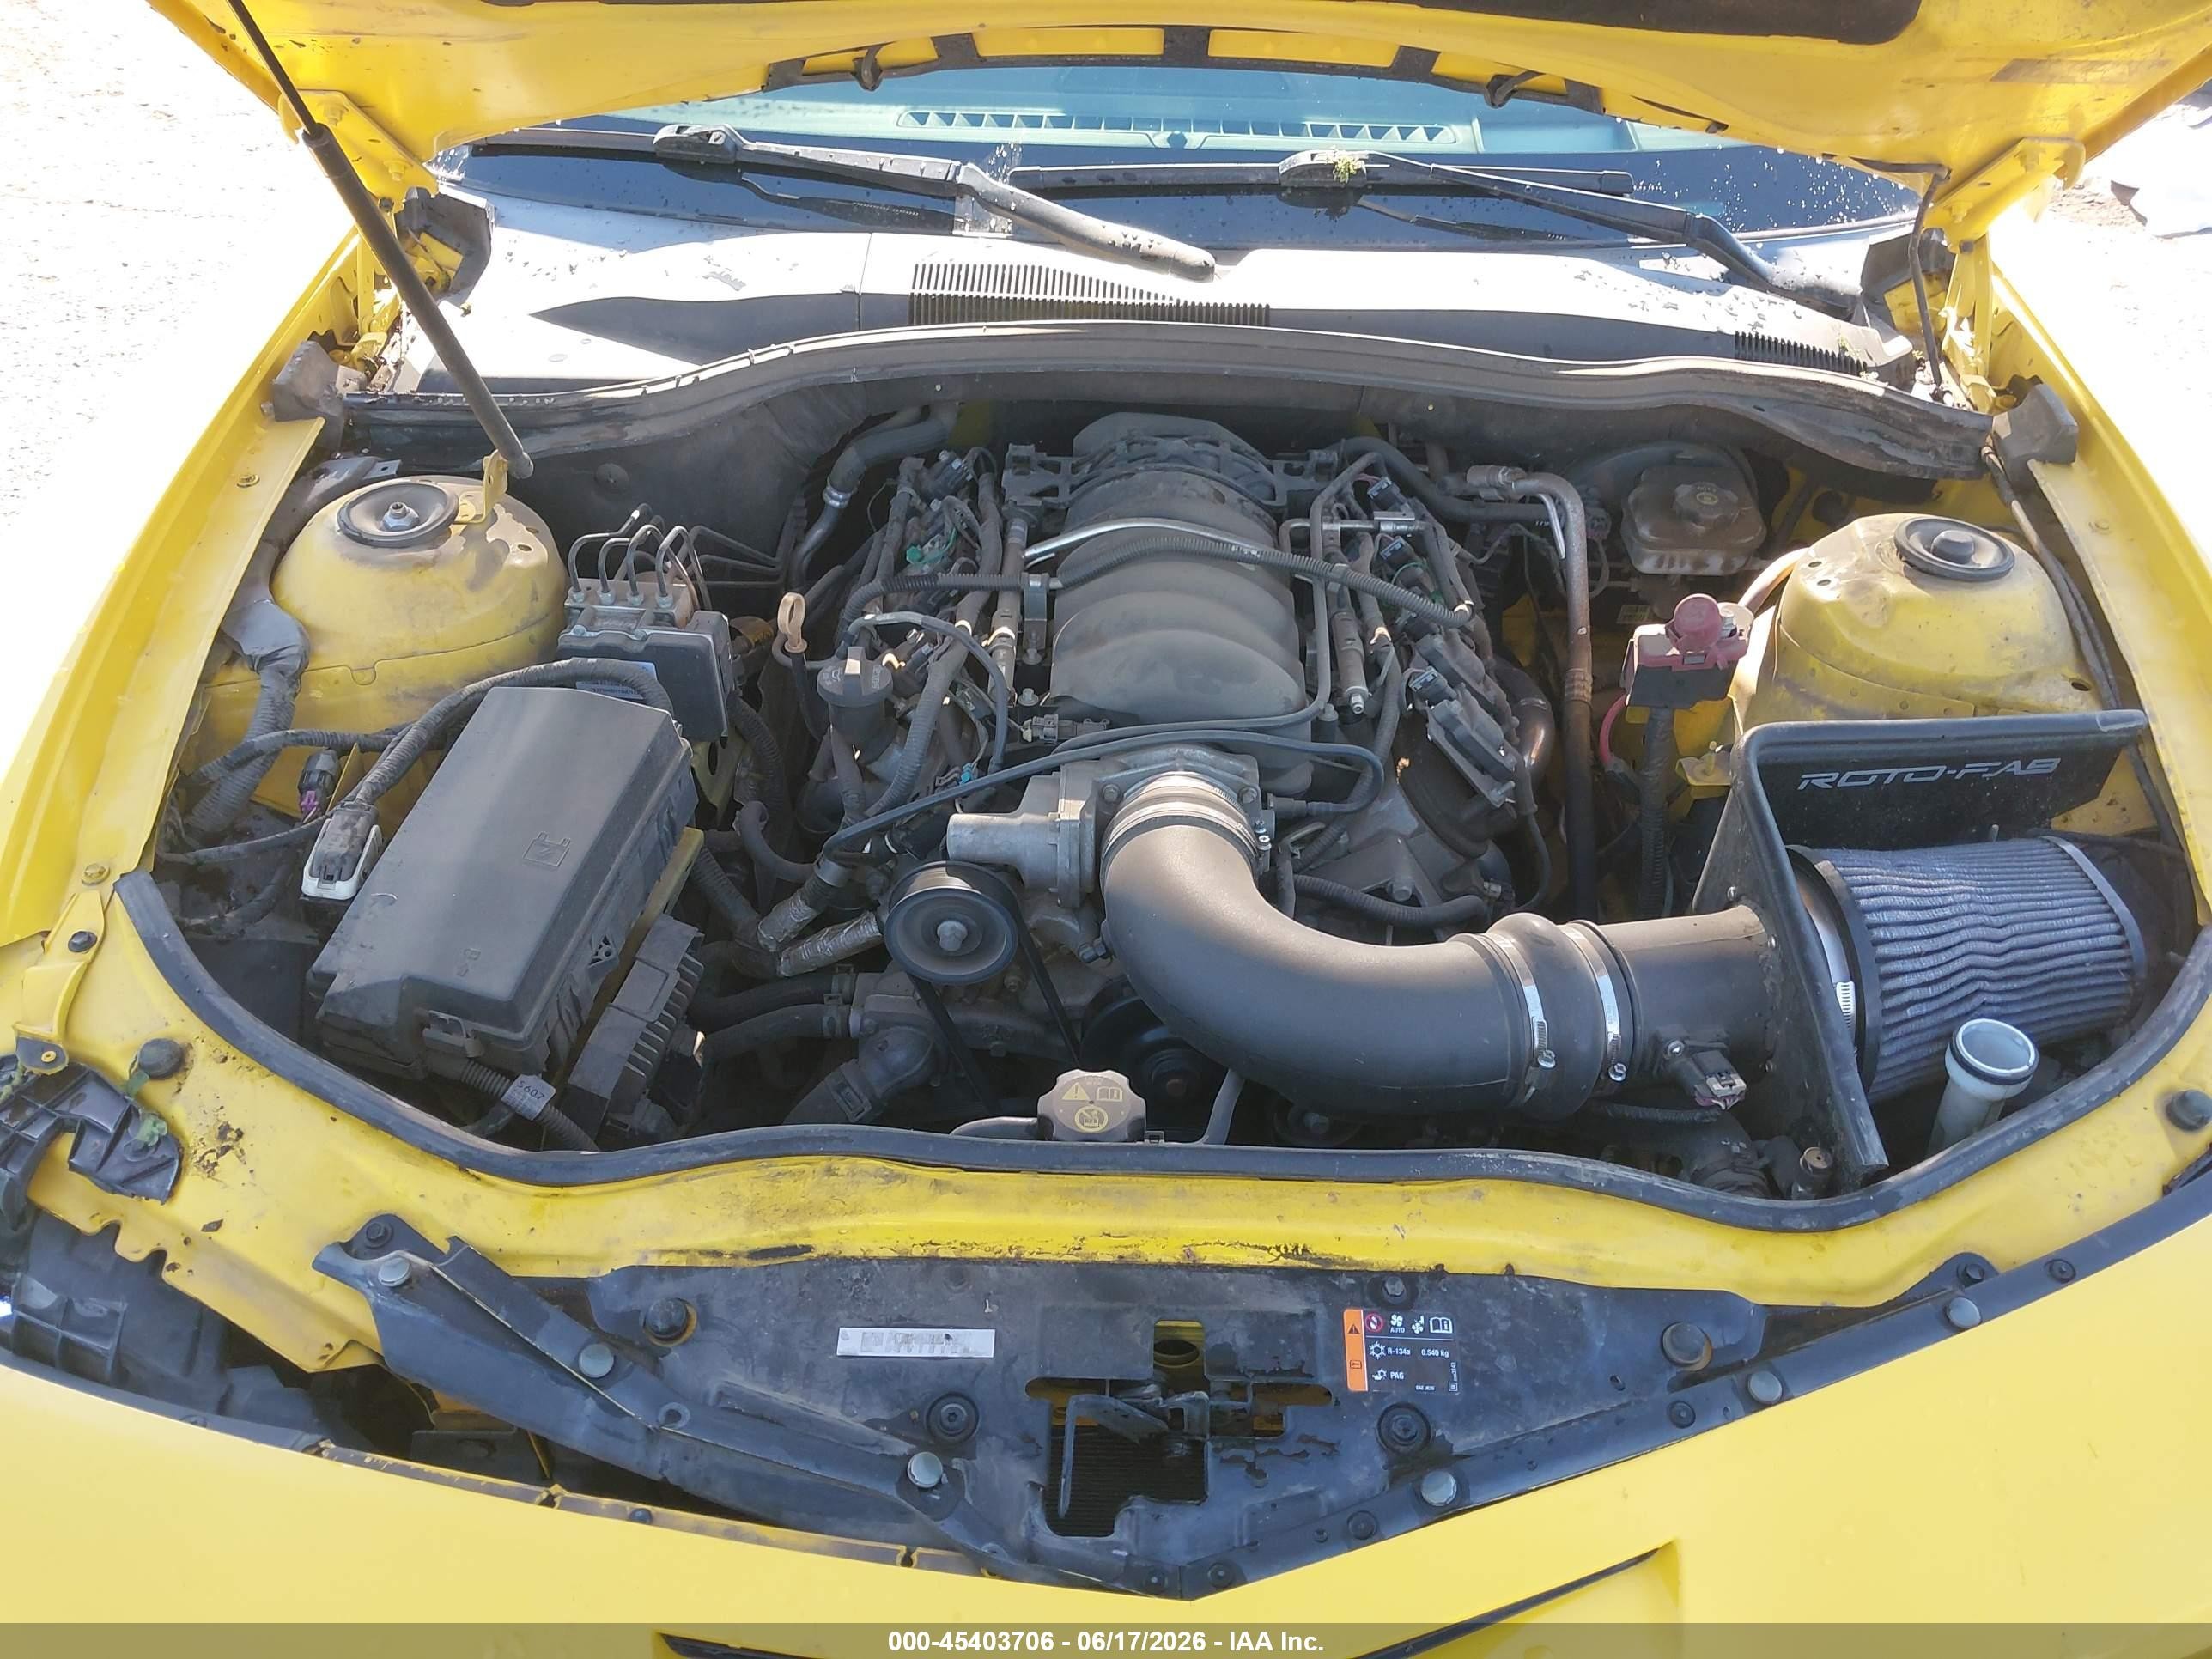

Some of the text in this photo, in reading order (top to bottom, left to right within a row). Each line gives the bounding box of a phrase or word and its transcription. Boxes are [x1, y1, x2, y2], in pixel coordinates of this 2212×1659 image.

[1797, 757, 2061, 791] ROTO-FAB
[1440, 1350, 1449, 1358] kg
[1390, 1371, 1405, 1380] PAG
